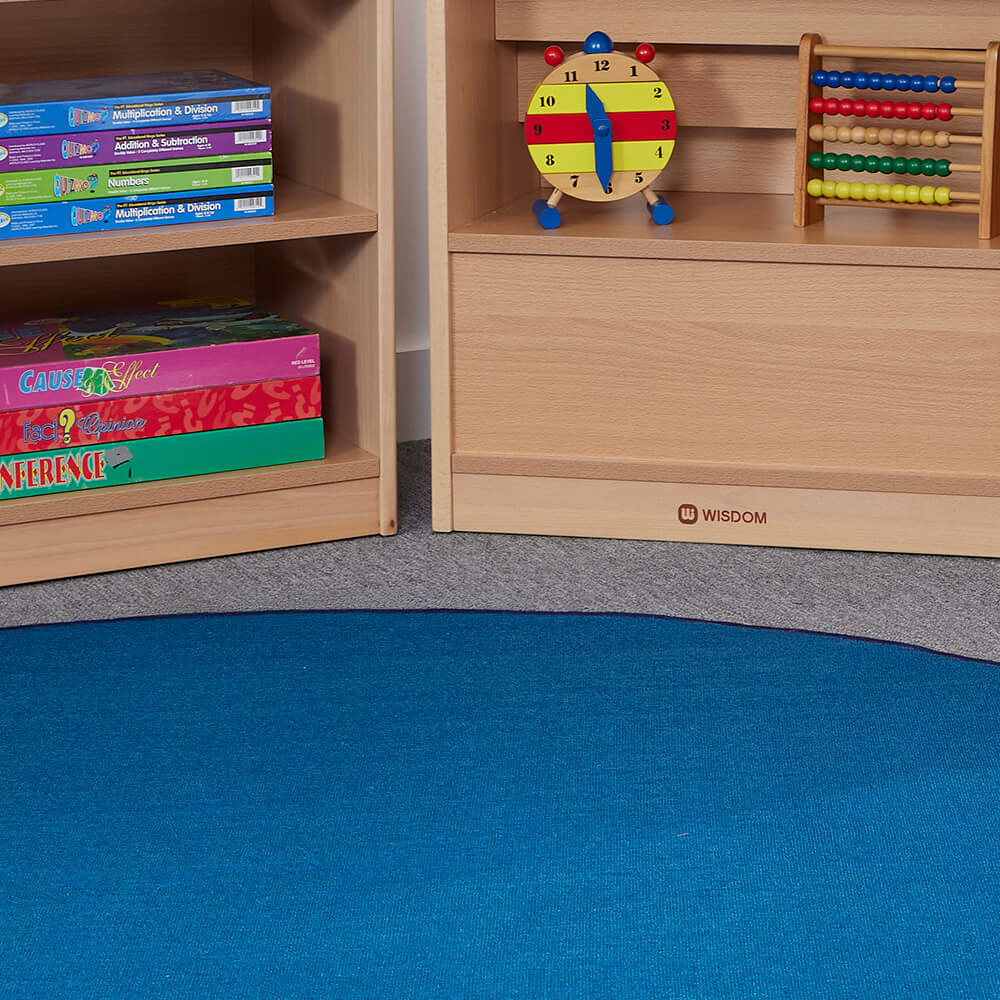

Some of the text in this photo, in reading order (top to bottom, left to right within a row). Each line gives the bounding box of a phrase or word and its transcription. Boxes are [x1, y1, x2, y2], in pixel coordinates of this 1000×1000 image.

[594, 60, 610, 71] 12
[630, 66, 639, 77] 1
[564, 71, 578, 82] 11
[654, 87, 662, 98] 2
[539, 96, 555, 107] 10
[112, 107, 172, 121] Multiplication
[174, 106, 182, 115] &
[184, 104, 218, 115] Division
[534, 125, 542, 136] 9
[661, 119, 670, 131] 3
[114, 139, 150, 151] Addition
[151, 139, 160, 148] &
[161, 136, 208, 147] Subtraction
[655, 146, 663, 158] 4
[546, 154, 555, 166] 8
[107, 177, 149, 188] Numbers
[570, 175, 579, 188] 7
[635, 172, 643, 183] 5
[115, 206, 175, 219] Multiplication
[177, 204, 185, 213] &
[187, 201, 221, 213] Division
[19, 368, 84, 394] CAUSE
[101, 360, 160, 392] Effect
[76, 411, 148, 442] Opinion
[702, 508, 767, 524] WISDOM
